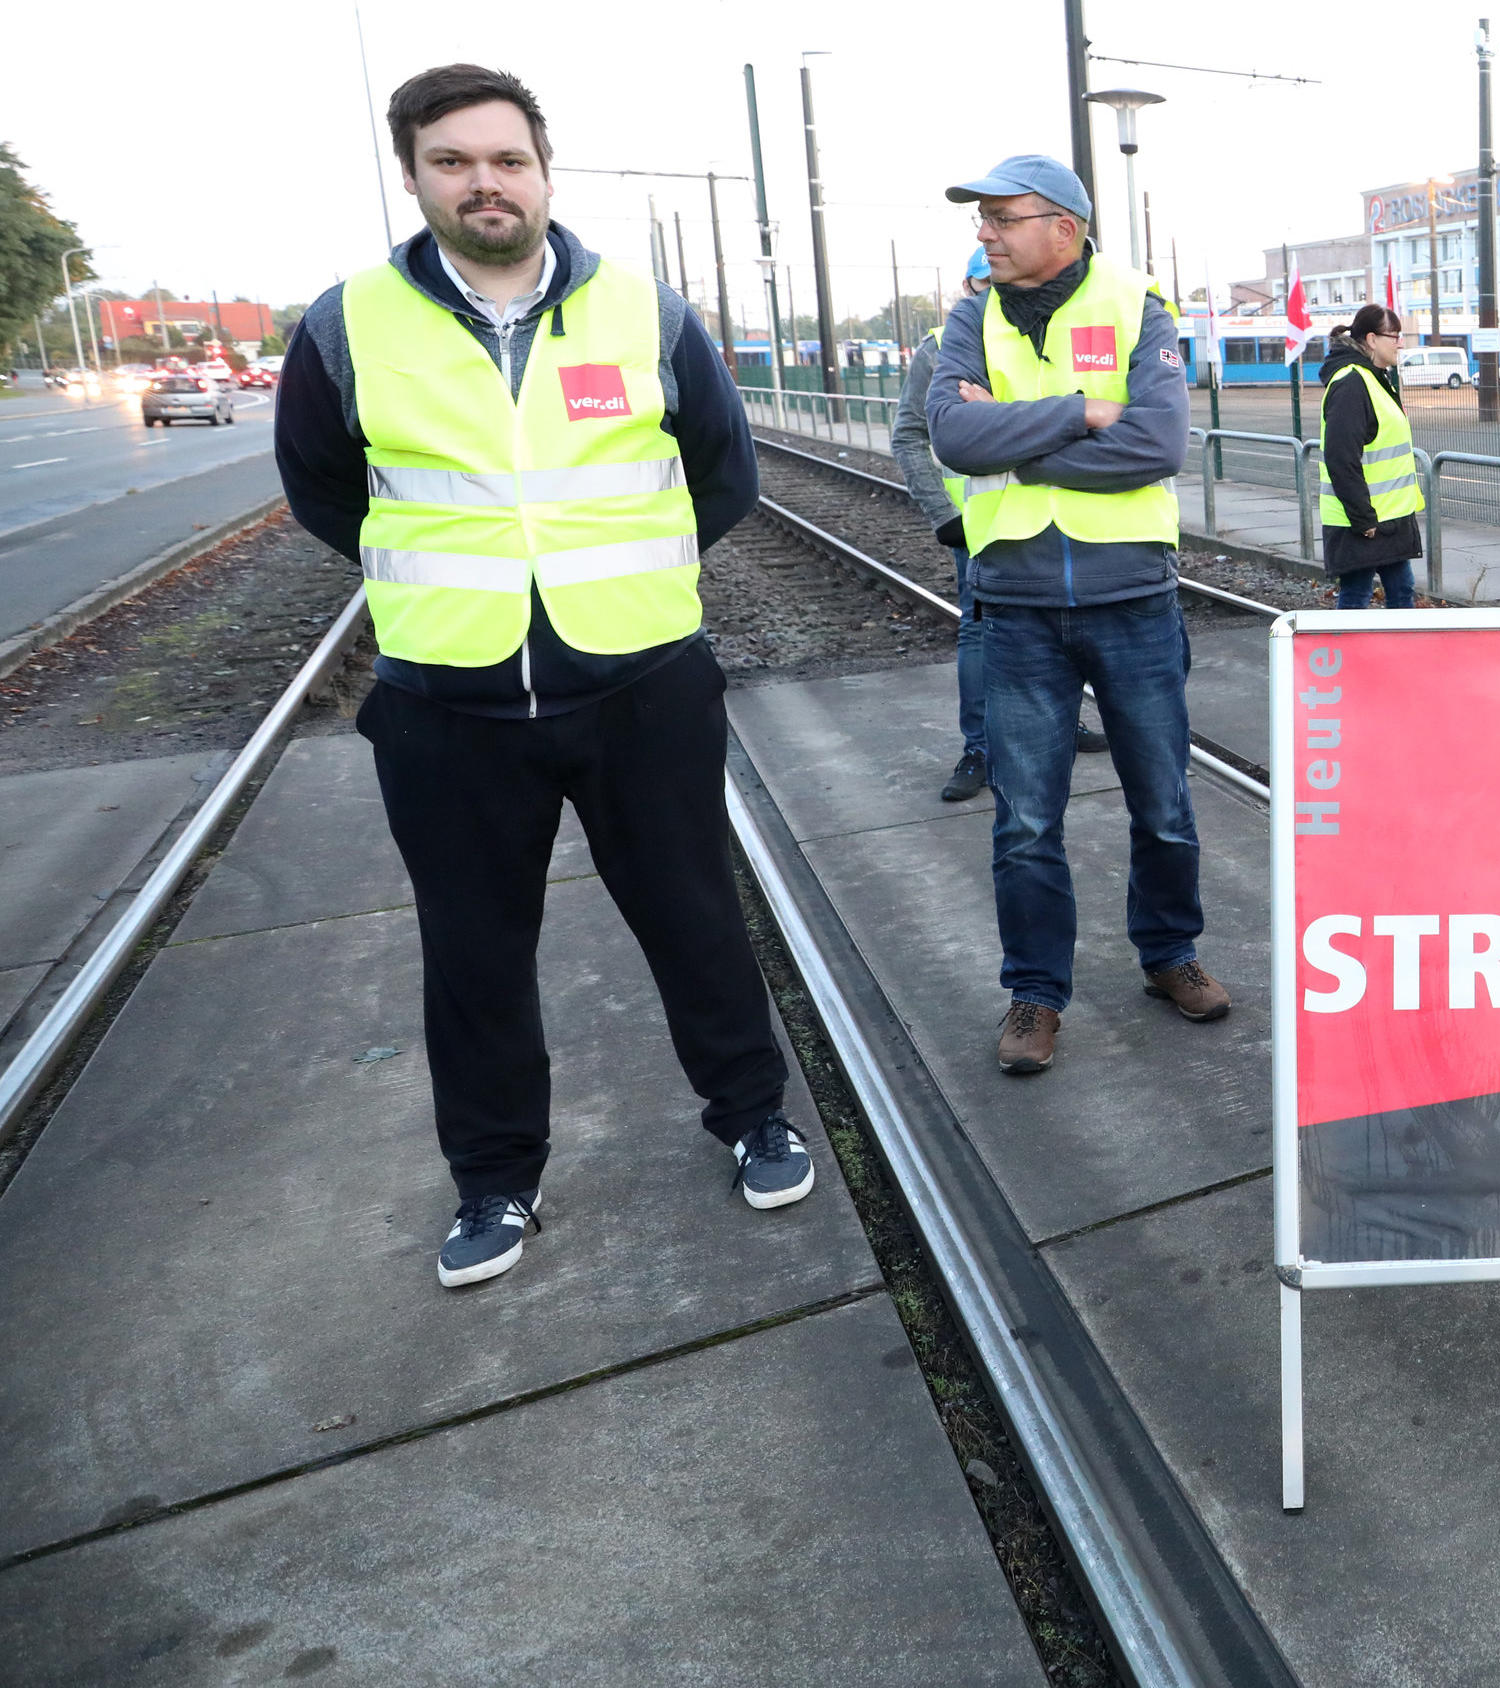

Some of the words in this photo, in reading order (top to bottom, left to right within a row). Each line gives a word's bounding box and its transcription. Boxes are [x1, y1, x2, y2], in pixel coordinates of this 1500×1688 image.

[1075, 352, 1114, 366] ver.di
[569, 396, 625, 410] ver.di
[1295, 638, 1343, 836] Heute
